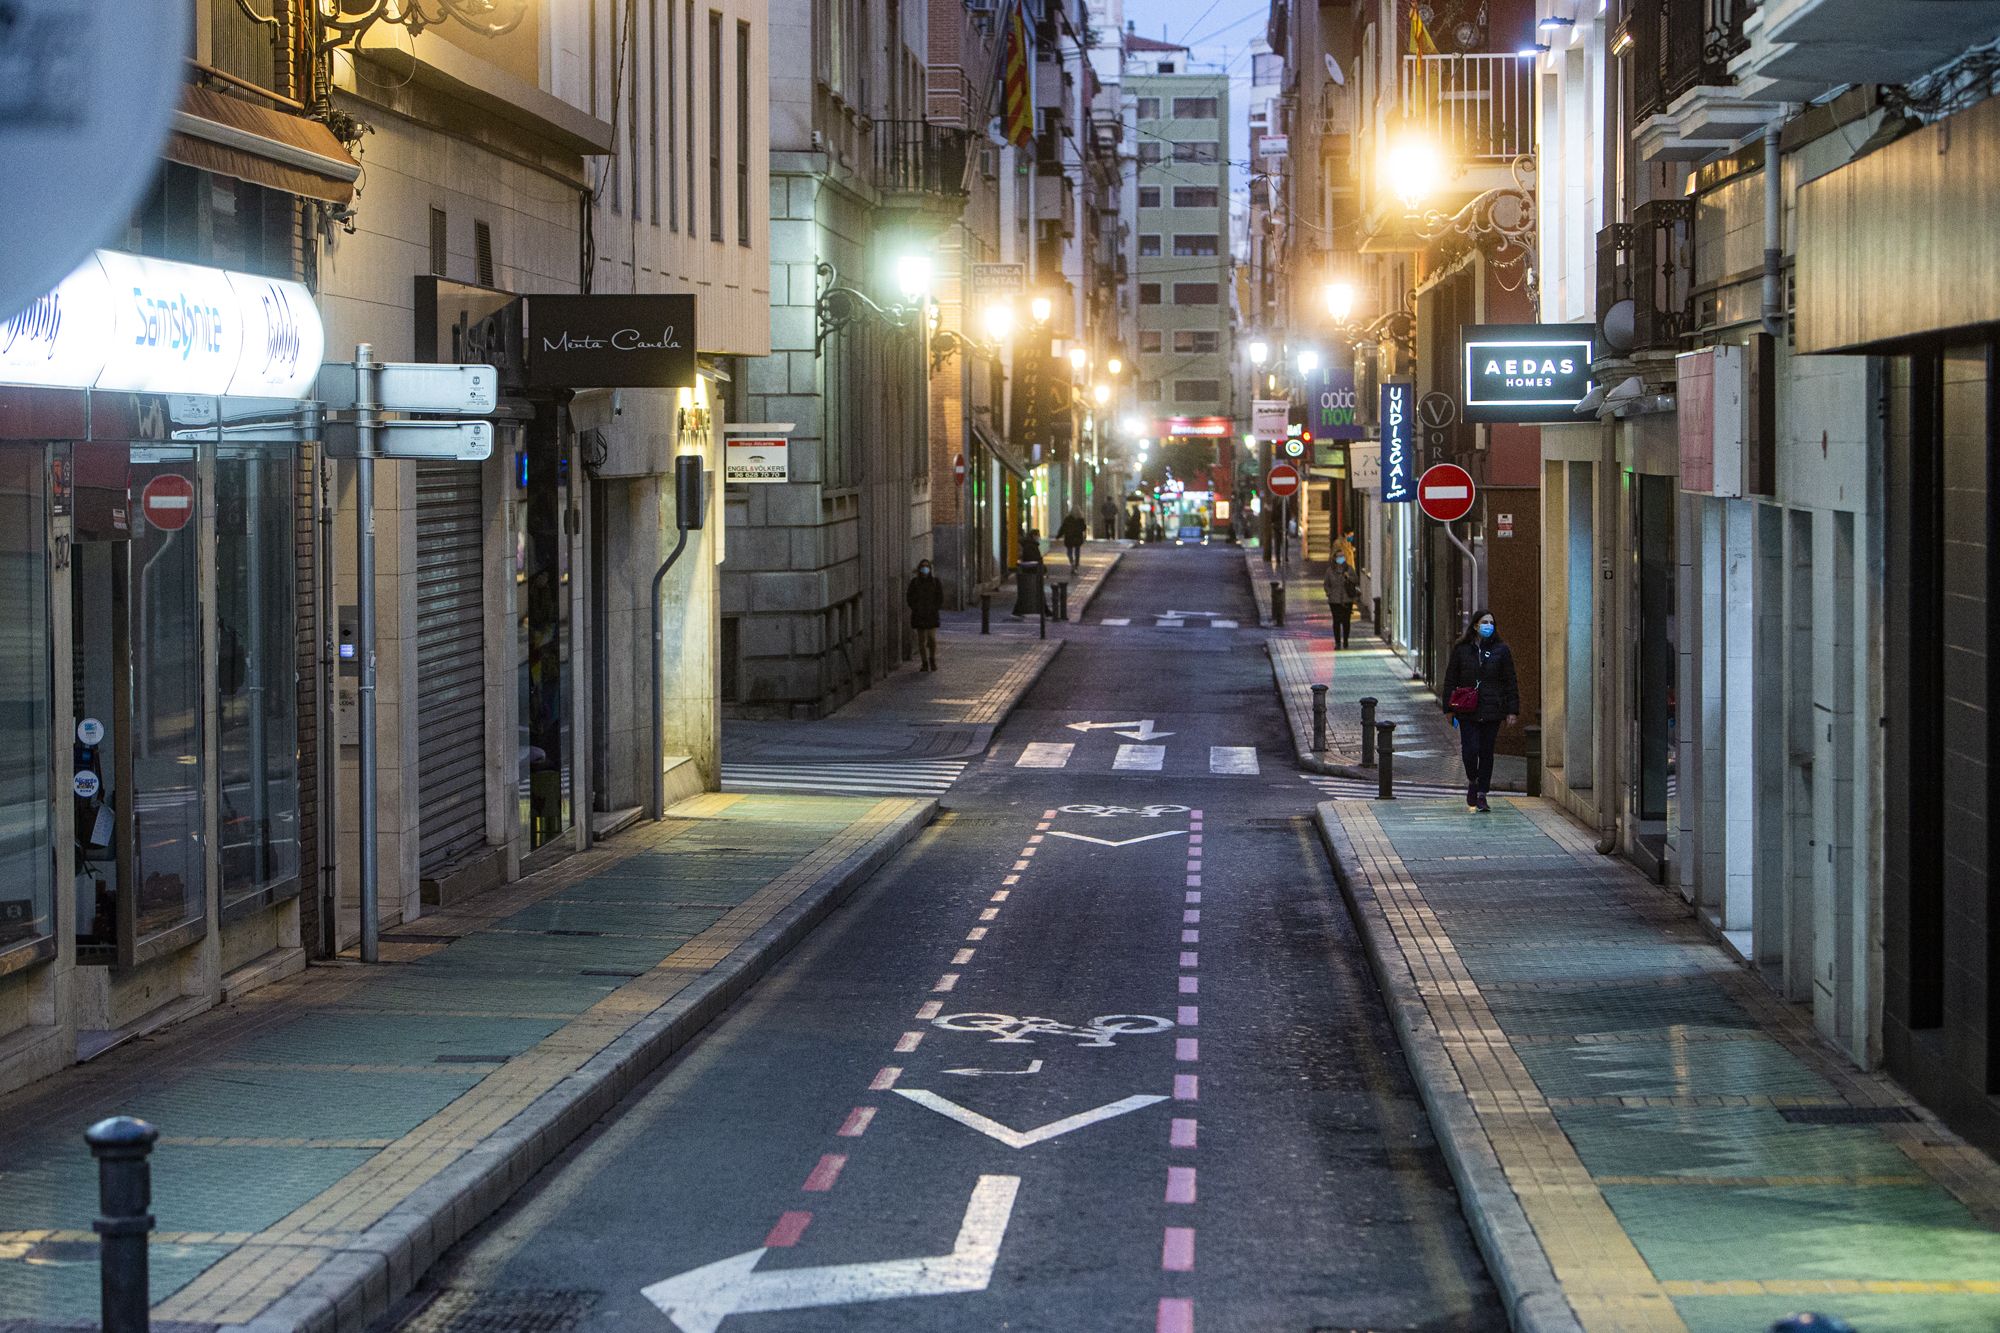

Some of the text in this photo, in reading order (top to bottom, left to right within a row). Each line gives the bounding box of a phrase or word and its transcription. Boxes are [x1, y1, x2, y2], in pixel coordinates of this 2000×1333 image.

[132, 287, 223, 361] Samsonite
[543, 325, 682, 352] Menta Canela
[1484, 359, 1574, 375] AEDAS
[1505, 378, 1552, 387] HOMES
[1389, 386, 1404, 490] UNDISCAL
